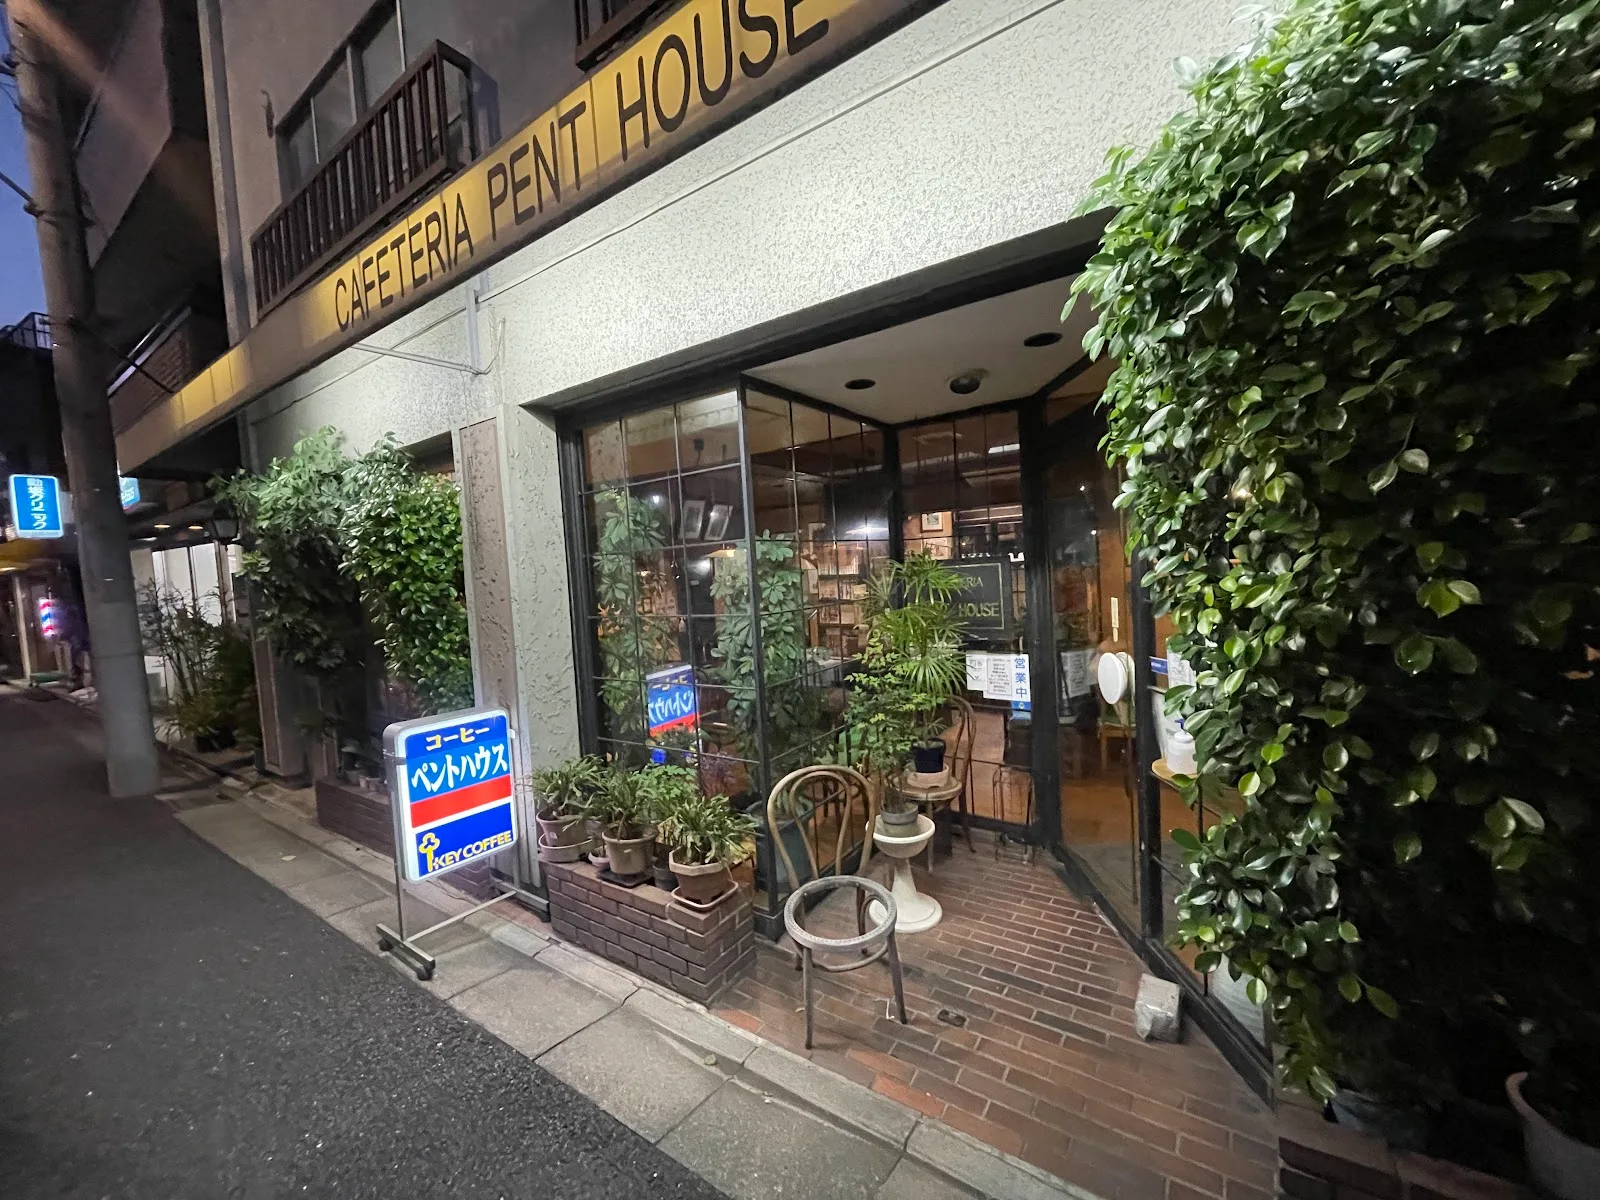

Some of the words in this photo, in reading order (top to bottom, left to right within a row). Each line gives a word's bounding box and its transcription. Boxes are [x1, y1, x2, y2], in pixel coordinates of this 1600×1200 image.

[334, 192, 474, 333] CAFETERIA
[486, 100, 587, 241] PENT
[1014, 657, 1028, 699] 営業中
[425, 727, 490, 751] コーヒー
[411, 743, 508, 792] ペントハウス
[432, 849, 463, 870] KEY
[462, 830, 512, 858] COFFEE
